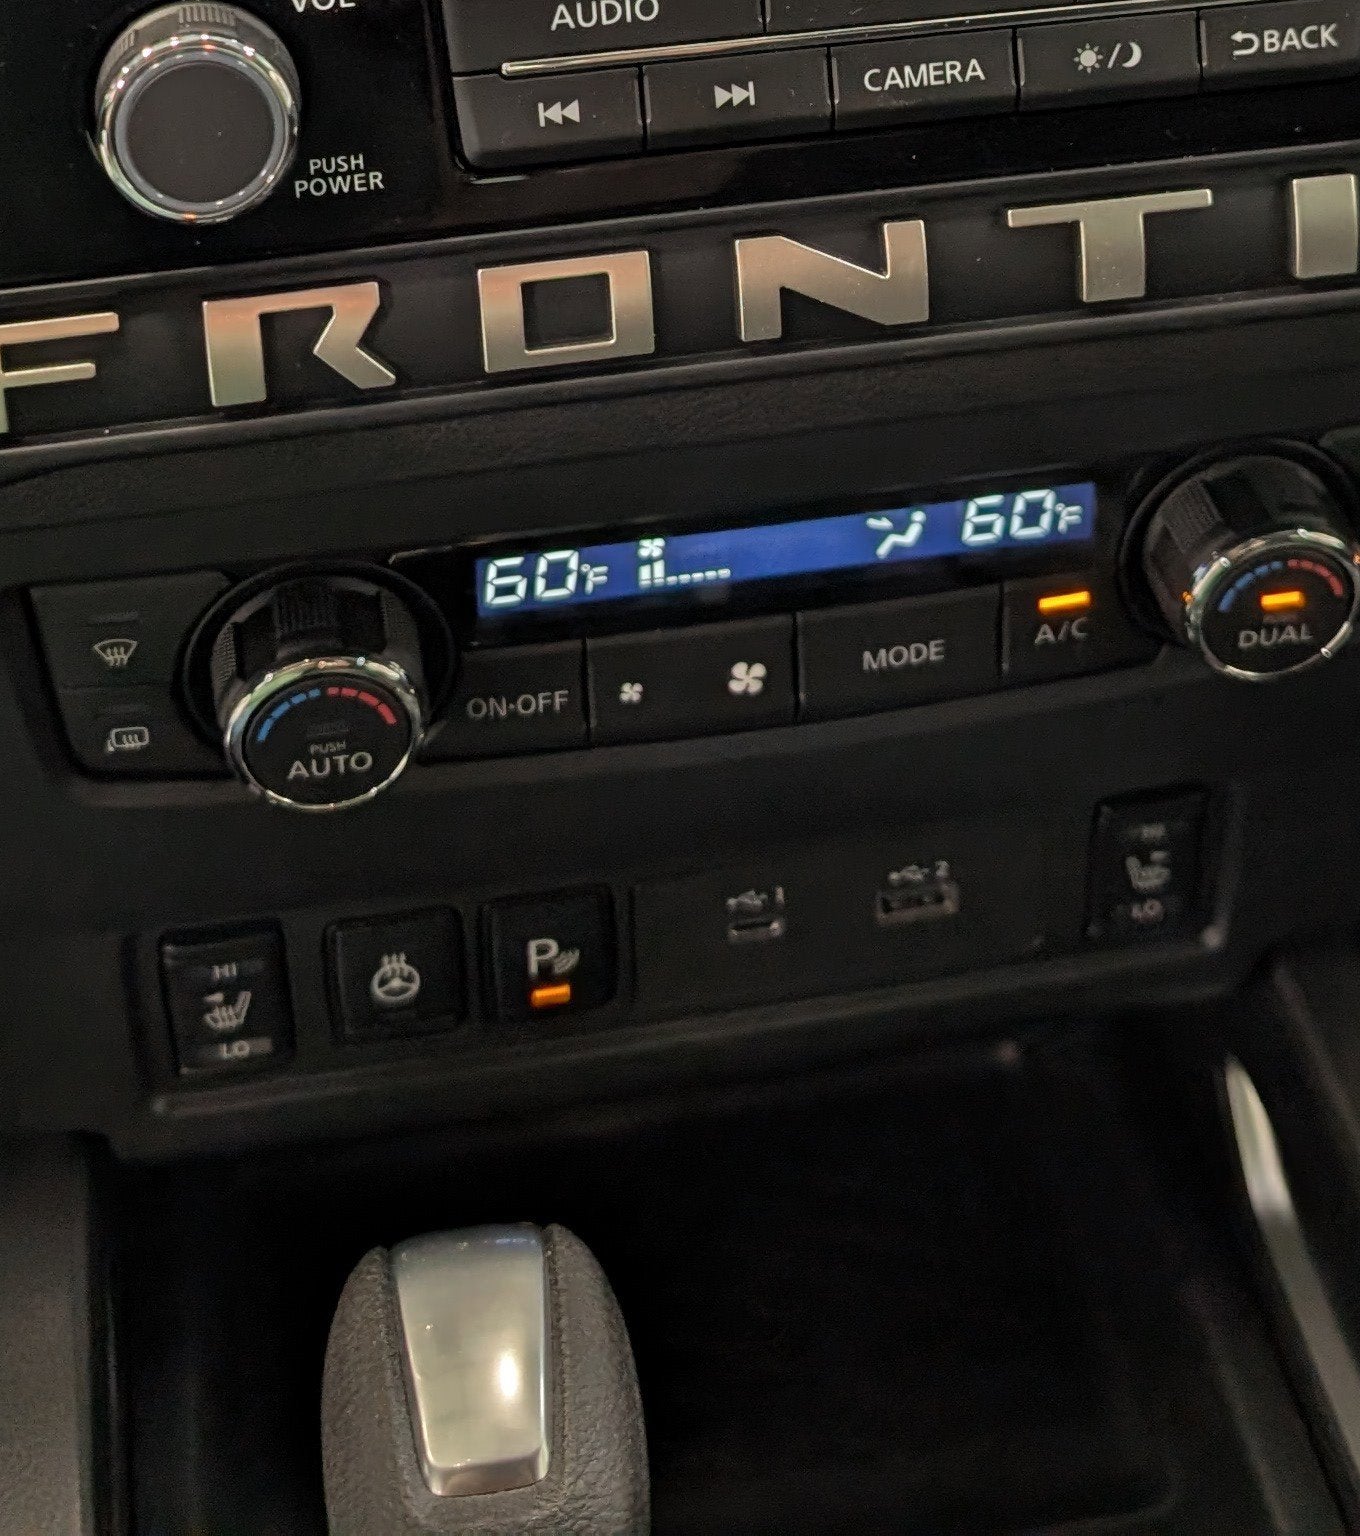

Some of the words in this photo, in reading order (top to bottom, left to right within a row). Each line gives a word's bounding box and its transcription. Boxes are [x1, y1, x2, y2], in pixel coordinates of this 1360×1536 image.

[1262, 22, 1340, 54] BACK
[863, 57, 986, 93] CAMERA
[308, 152, 366, 177] PUSH
[293, 170, 386, 200] POWER
[1033, 614, 1090, 646] A/C
[1239, 623, 1314, 649] DUAL
[861, 638, 946, 673] MODE
[286, 750, 375, 781] AUTO
